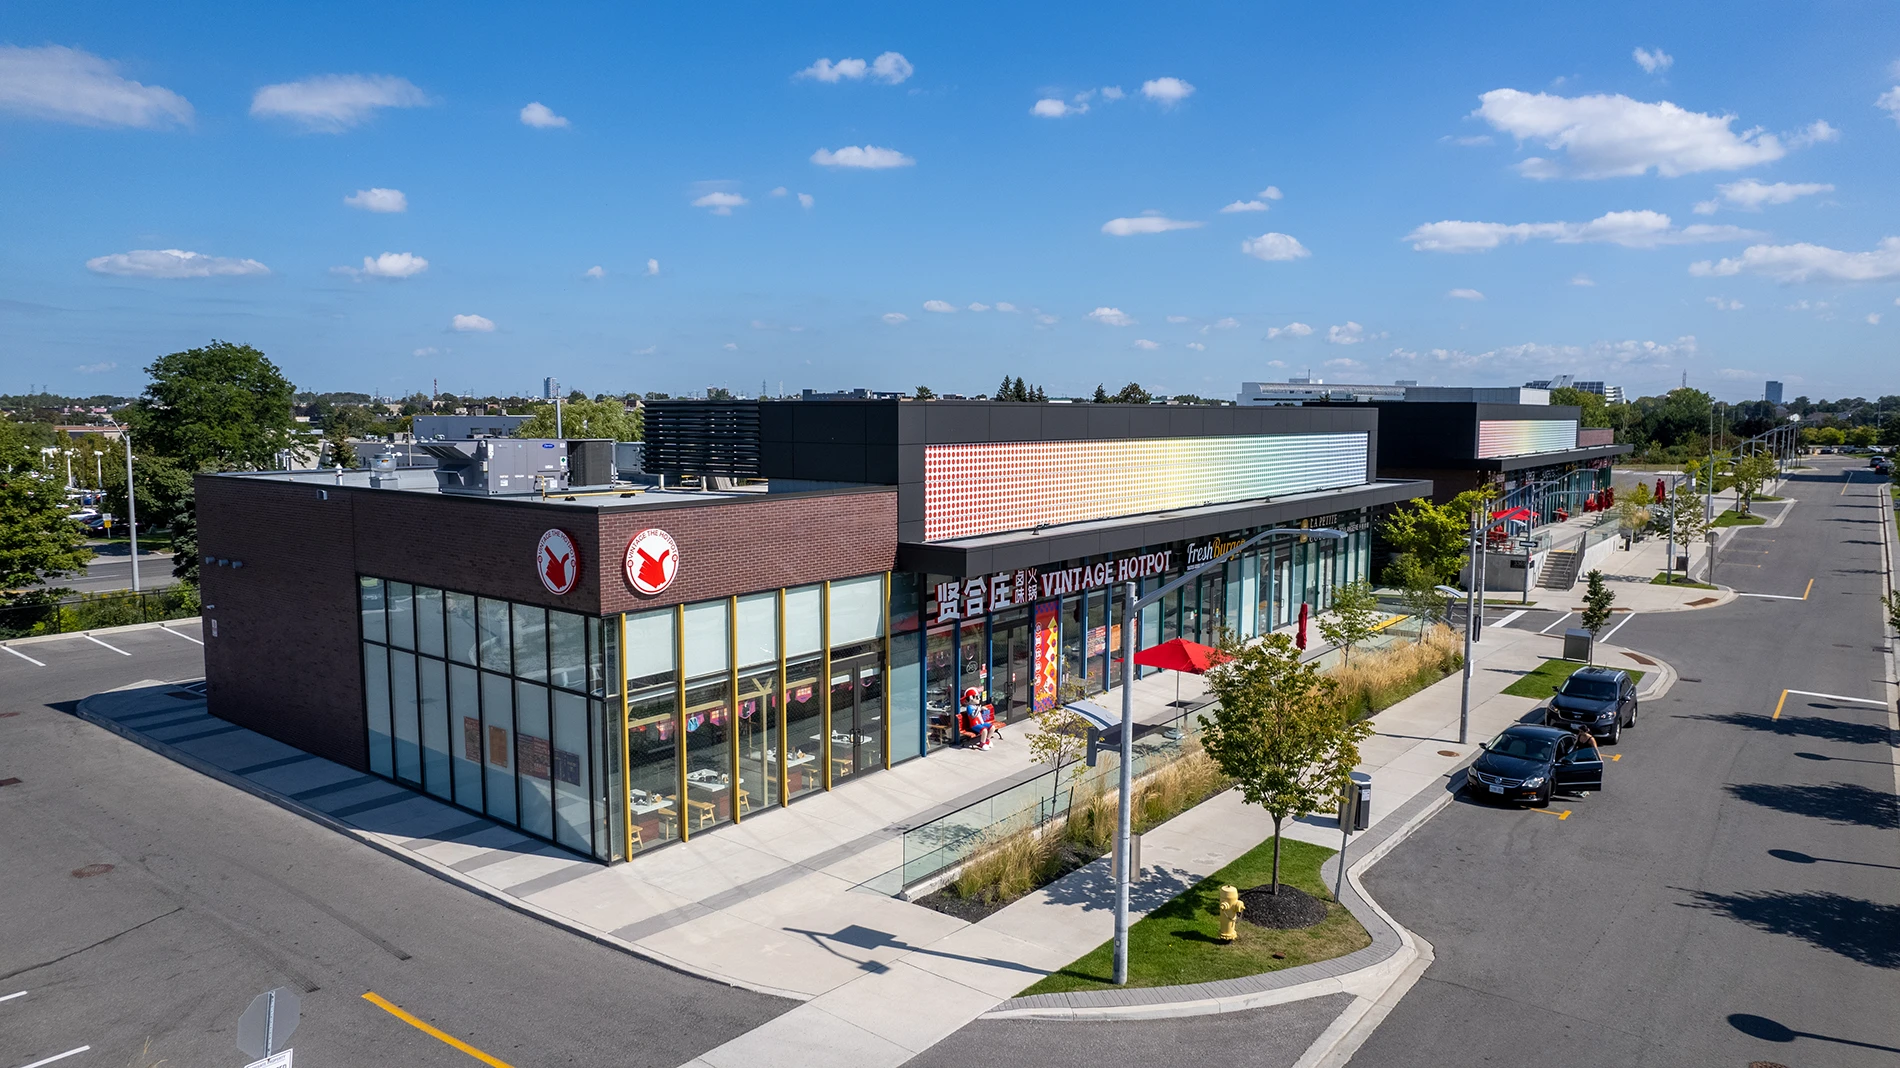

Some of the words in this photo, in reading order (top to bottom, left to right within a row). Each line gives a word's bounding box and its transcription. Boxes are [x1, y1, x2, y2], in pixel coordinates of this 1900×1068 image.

[628, 532, 647, 559] VINTAGE
[659, 532, 678, 554] HOTPOT
[935, 572, 1010, 623] 贤合庄
[1040, 561, 1115, 598] VINTAGE
[1117, 550, 1172, 582] HOTPOT
